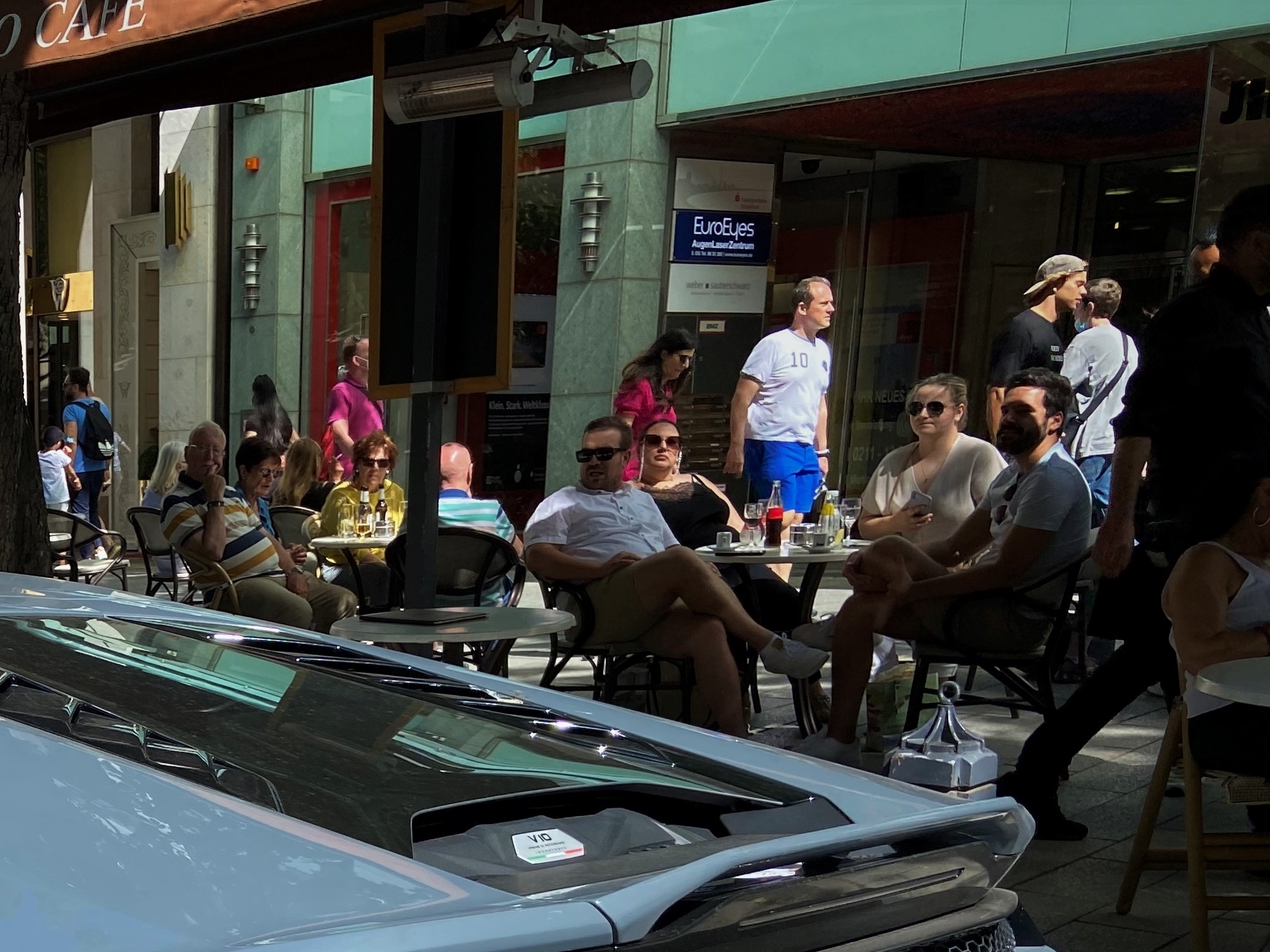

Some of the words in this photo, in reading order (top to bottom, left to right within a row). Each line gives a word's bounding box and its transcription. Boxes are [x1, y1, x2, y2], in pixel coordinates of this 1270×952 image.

[693, 216, 755, 241] EuroEyes
[691, 239, 755, 250] AugenLaserZentrum
[790, 352, 808, 368] 10
[527, 832, 552, 844] V10
